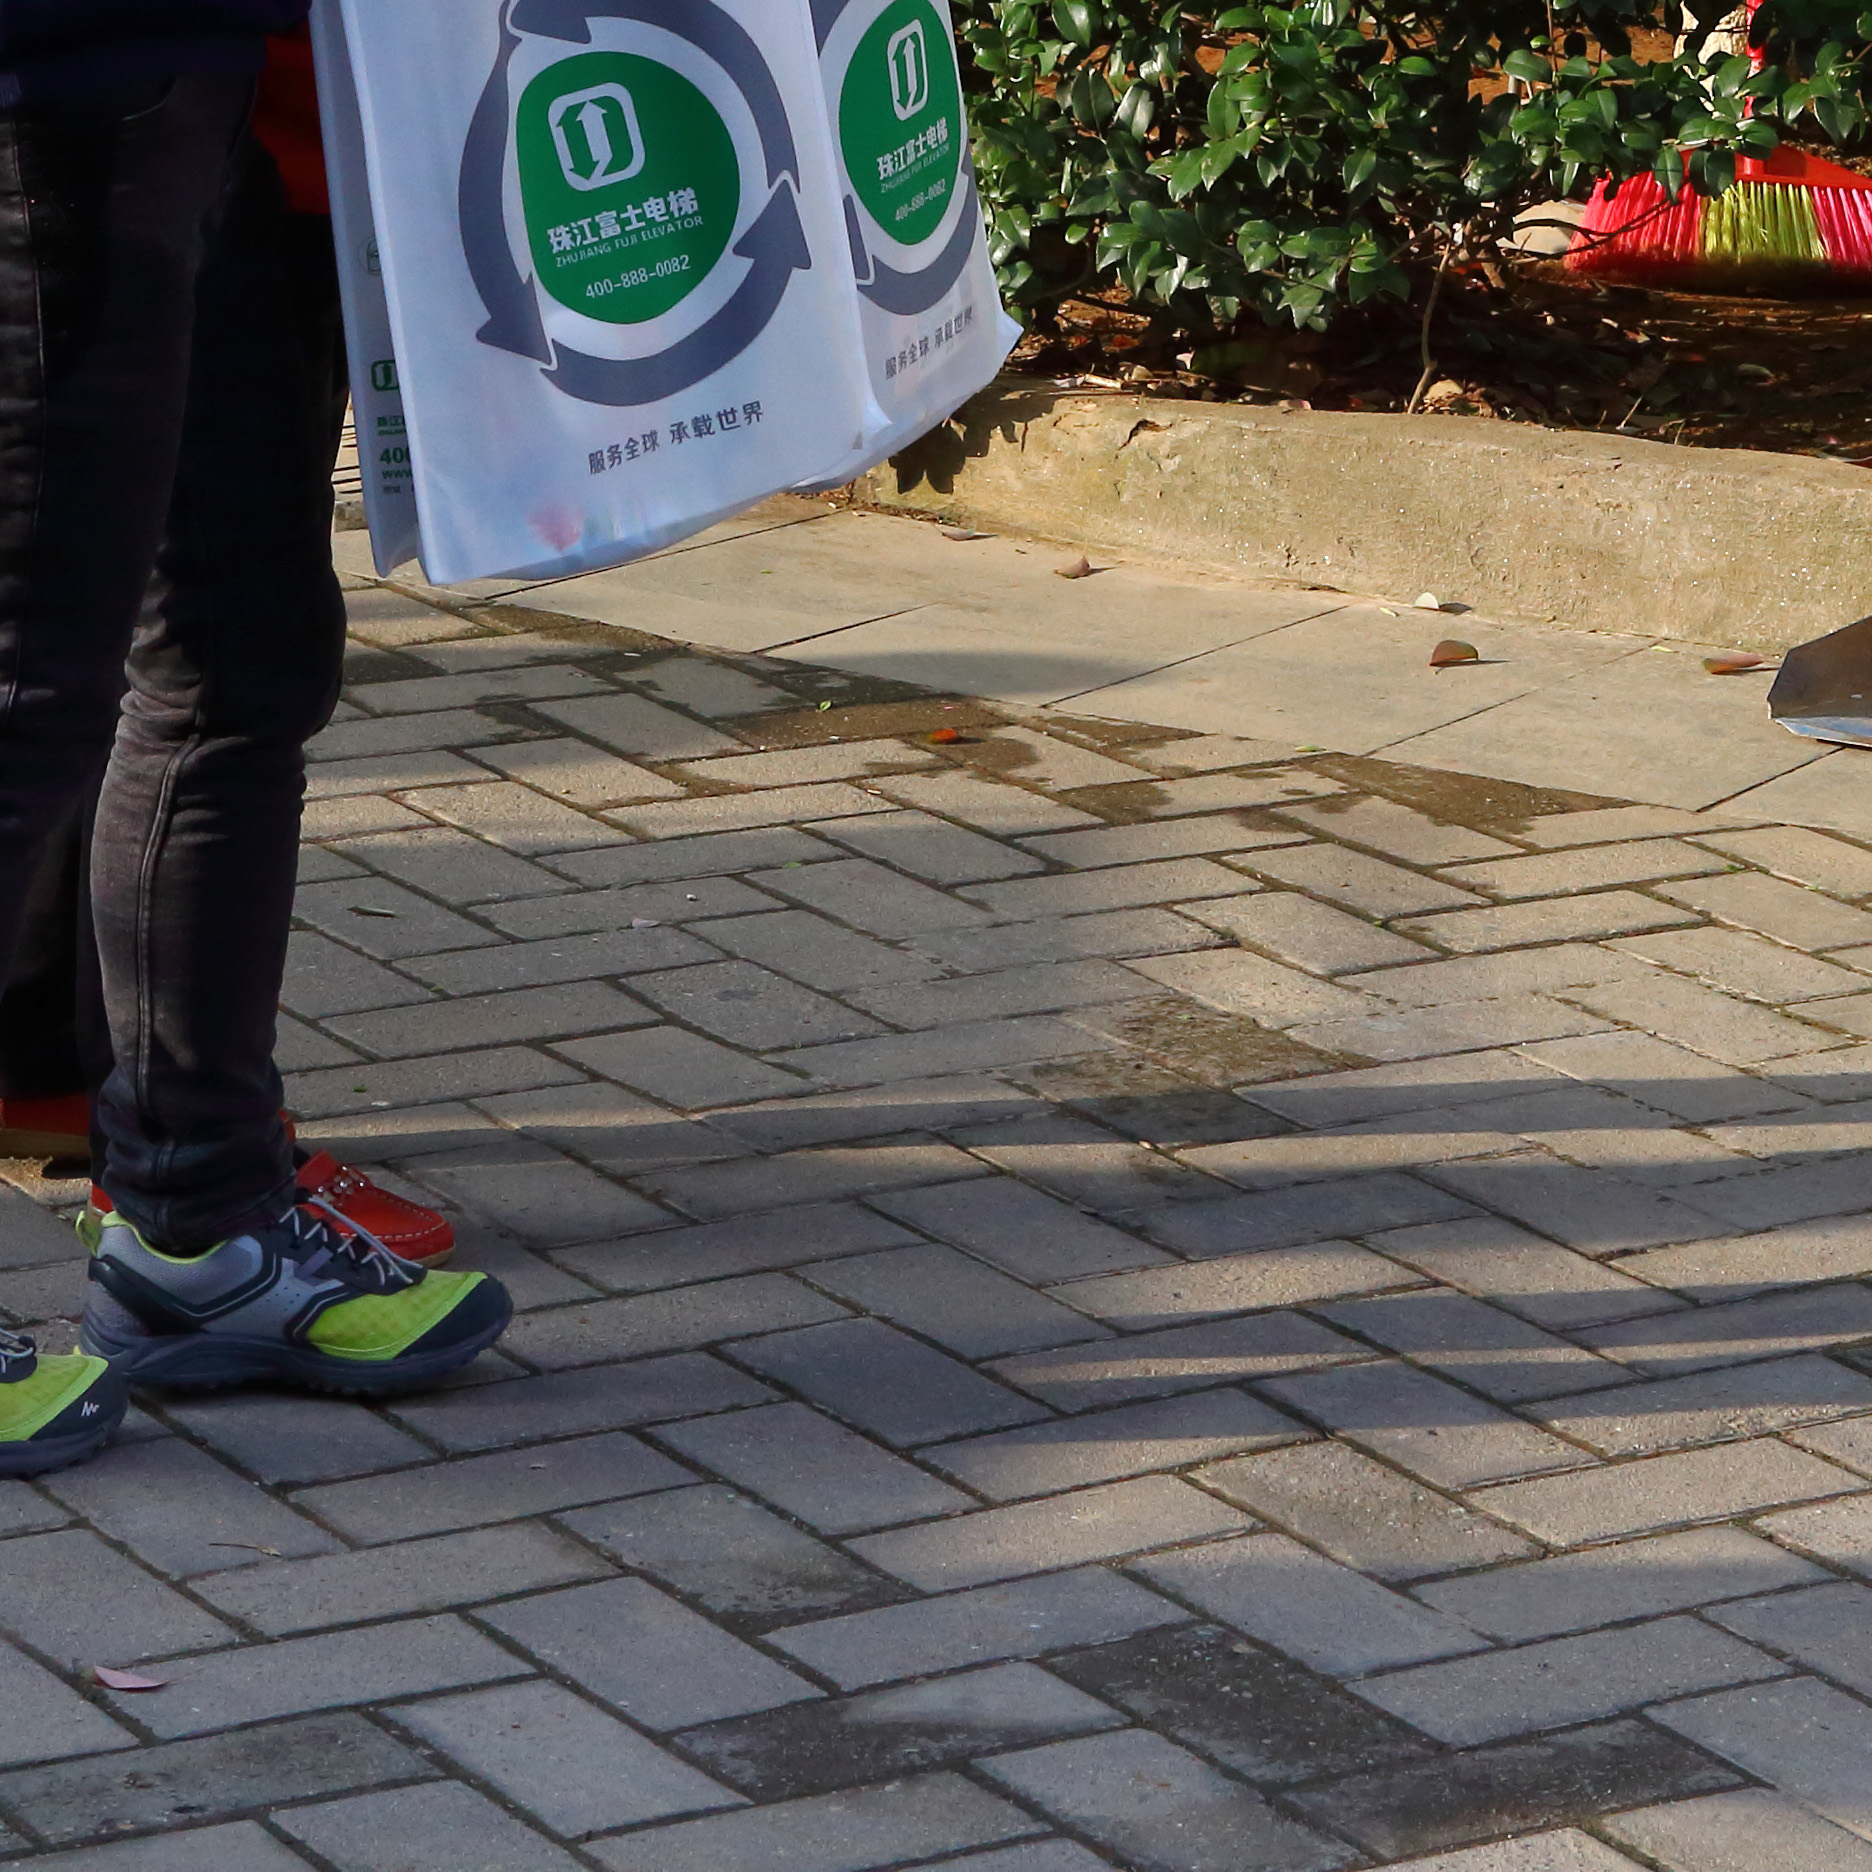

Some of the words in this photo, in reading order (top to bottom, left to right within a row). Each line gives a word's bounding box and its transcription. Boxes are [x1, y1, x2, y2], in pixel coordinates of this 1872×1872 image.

[876, 116, 949, 181] 珠江富士电梯
[546, 186, 699, 255] 珠江富士电梯
[555, 242, 612, 268] ZHUJIANG
[614, 233, 639, 250] FUJI
[640, 215, 704, 242] ELEVATOR
[585, 254, 692, 299] 400-888-0082
[885, 334, 930, 381] 服务全球
[588, 429, 661, 476] 服务全球
[669, 400, 764, 446] 承载世界
